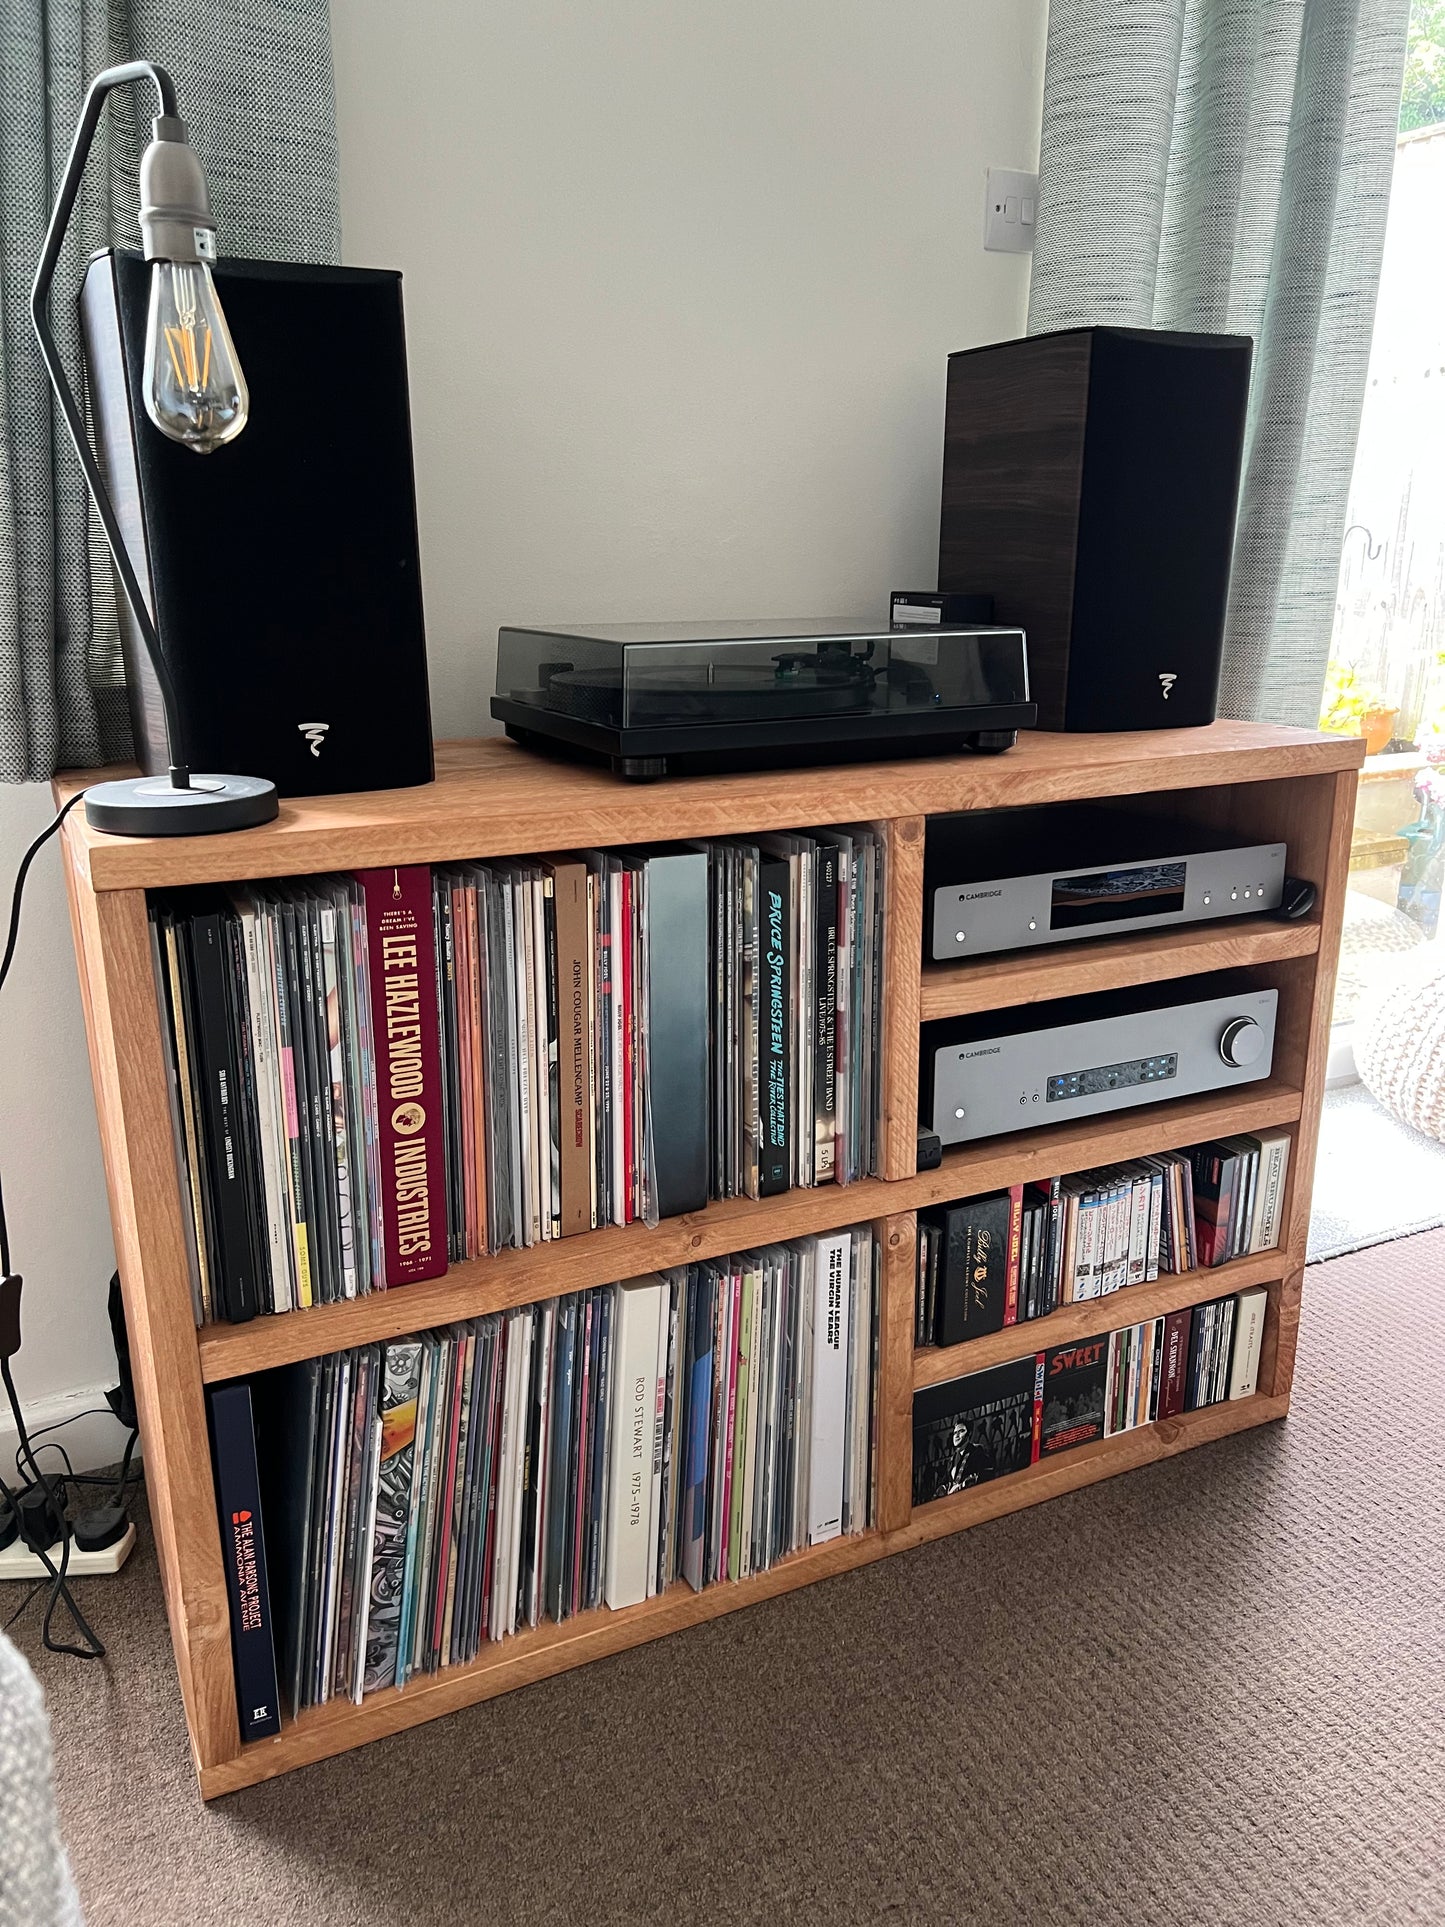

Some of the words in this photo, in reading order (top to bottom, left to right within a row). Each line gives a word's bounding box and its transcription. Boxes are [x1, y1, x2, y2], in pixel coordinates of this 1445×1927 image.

[966, 890, 1002, 900] CAMBRIDGE
[768, 891, 782, 951] BRUCE
[383, 934, 418, 970] LEE
[827, 926, 835, 955] BRUCE
[573, 960, 581, 988] JOHN
[827, 956, 835, 1015] SPRINGSTEEN
[573, 991, 582, 1035] COUGAR
[767, 951, 784, 1054] SPRINGSTEEN
[384, 972, 424, 1100] HAZLEWOOD
[966, 1047, 1001, 1058] CAMBRIDGE
[574, 1038, 582, 1106] MELLENCAMP
[220, 1082, 228, 1105] ANTHOLOGY
[768, 1080, 776, 1106] RIVER
[224, 1137, 234, 1153] LINDSEY
[226, 1153, 235, 1179] BUCKINGHAM
[1272, 1148, 1280, 1178] BEAU
[394, 1138, 431, 1255] INDUSTRIES
[1012, 1202, 1020, 1233] BILLY
[1263, 1181, 1276, 1247] BRUMMELS
[973, 1230, 991, 1263] Billy
[301, 1269, 309, 1288] GUYS
[971, 1282, 988, 1309] Joel
[1170, 1331, 1179, 1345] DEL
[1049, 1342, 1105, 1376] SWEET
[1168, 1346, 1177, 1378] SHANNON
[635, 1377, 645, 1401] ROD
[632, 1406, 643, 1458] STEWART
[630, 1472, 641, 1526] 1975-1978
[240, 1521, 253, 1538] THE
[242, 1539, 255, 1560] ALAN
[232, 1526, 245, 1586] AMMONIA
[240, 1590, 251, 1631] AVENUE
[244, 1560, 258, 1596] PARSONS
[247, 1596, 262, 1629] PROJECT
